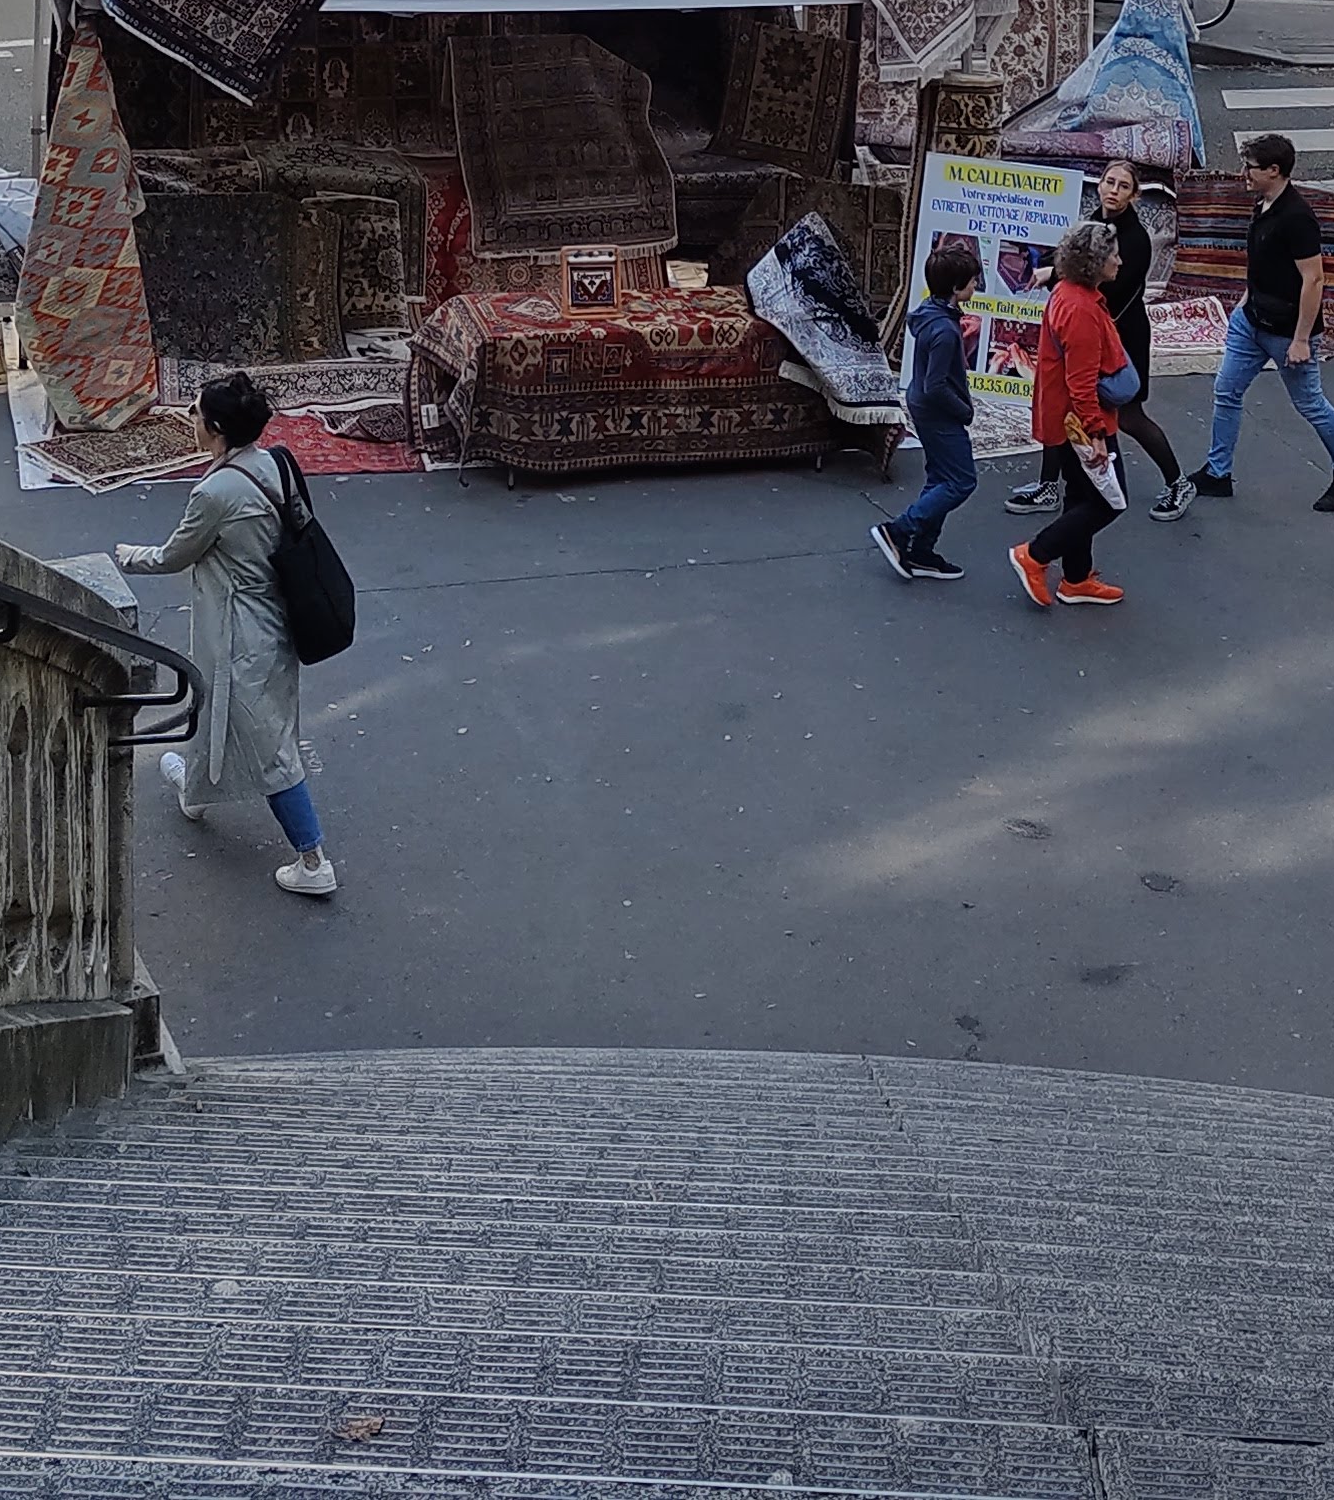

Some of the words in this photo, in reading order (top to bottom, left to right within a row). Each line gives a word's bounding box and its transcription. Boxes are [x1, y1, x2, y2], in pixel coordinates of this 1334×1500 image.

[949, 165, 964, 181] M.
[967, 168, 1062, 193] CALLEWAERT
[962, 187, 986, 200] Votre
[987, 191, 1032, 205] spécialiste
[1034, 200, 1044, 208] en
[932, 199, 971, 215] ENTRETIEN
[978, 204, 1020, 221] NETTOYAGE
[1025, 211, 1070, 228] REPARATION
[969, 219, 987, 232] DE
[989, 222, 1029, 238] TAPIS
[997, 301, 1014, 314] fait
